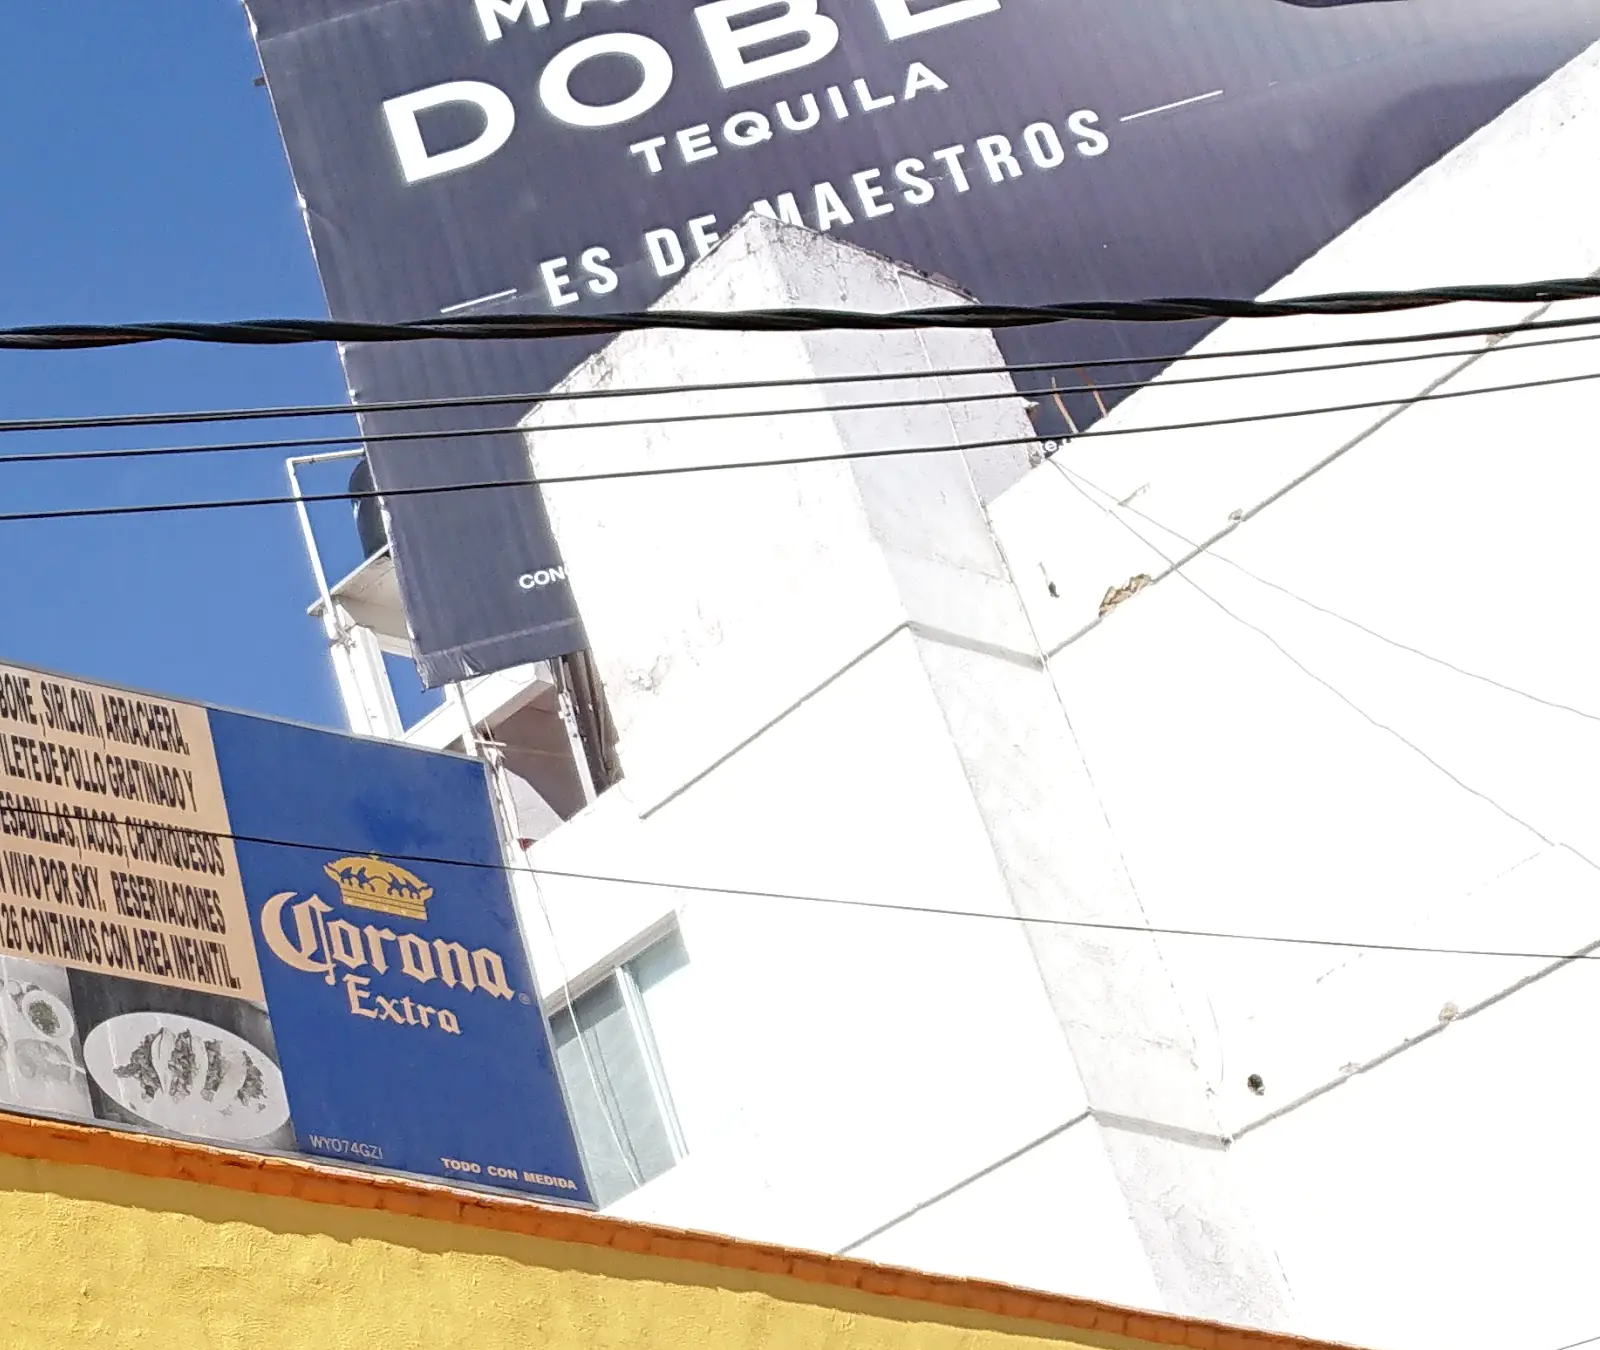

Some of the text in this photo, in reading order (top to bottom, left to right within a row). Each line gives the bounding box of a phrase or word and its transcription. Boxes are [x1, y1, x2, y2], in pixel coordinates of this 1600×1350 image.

[630, 61, 949, 174] TEQUILA
[540, 246, 619, 308] ES
[38, 740, 63, 786] DE
[58, 745, 107, 796] POLLO
[105, 753, 187, 812] GRATINADO
[182, 768, 198, 813] Y
[3, 850, 42, 901] VIVO
[38, 856, 75, 907] POR
[109, 868, 227, 936] RESERVACIONES
[20, 905, 104, 966] CONTAMOS
[100, 919, 136, 971] CON
[132, 926, 176, 979] AREA
[259, 890, 516, 1003] Corona
[341, 973, 464, 1037] Extra
[440, 1156, 579, 1191] TODO CON MEDIDA
